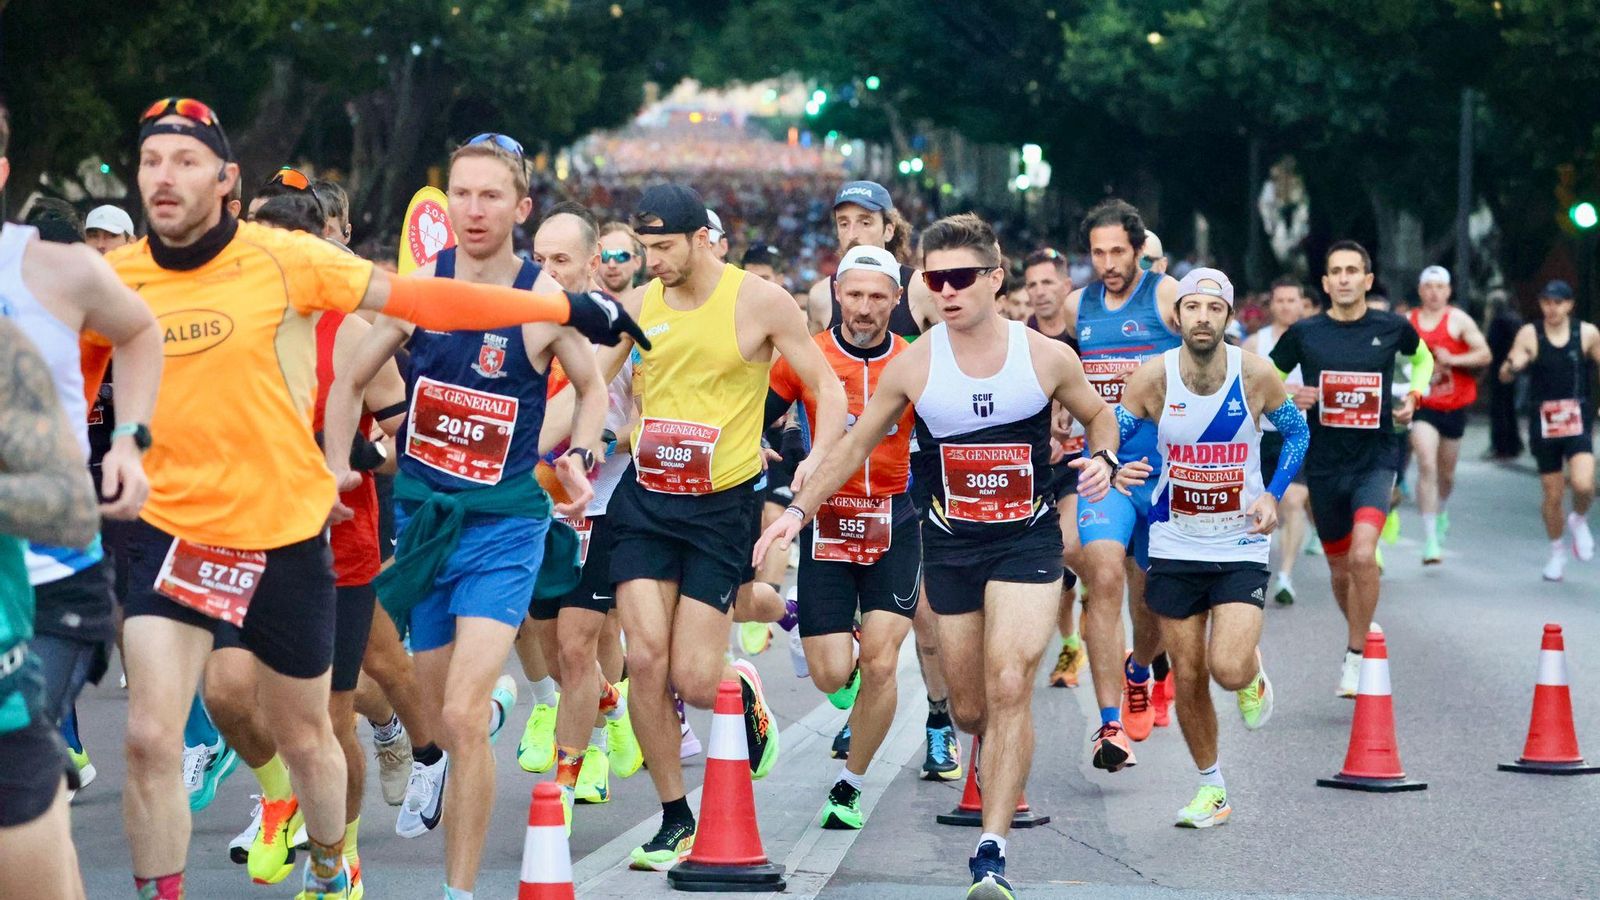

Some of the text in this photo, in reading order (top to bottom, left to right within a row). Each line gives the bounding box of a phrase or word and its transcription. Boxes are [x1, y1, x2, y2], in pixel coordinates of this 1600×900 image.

[840, 187, 873, 198] HOKA
[163, 319, 221, 343] ALBIS
[483, 332, 509, 345] KENT
[444, 388, 511, 416] GENERALI
[972, 393, 993, 401] SCUF
[436, 414, 485, 442] 2016
[448, 434, 469, 446] PETER
[655, 445, 692, 462] 3088
[965, 448, 1024, 461] GENERALI
[1166, 443, 1248, 464] MADRID
[966, 473, 1009, 488] 3086
[1187, 470, 1239, 482] GENERALI
[1184, 490, 1228, 505] 10179
[839, 518, 865, 533] 555
[198, 561, 255, 589] 5716
